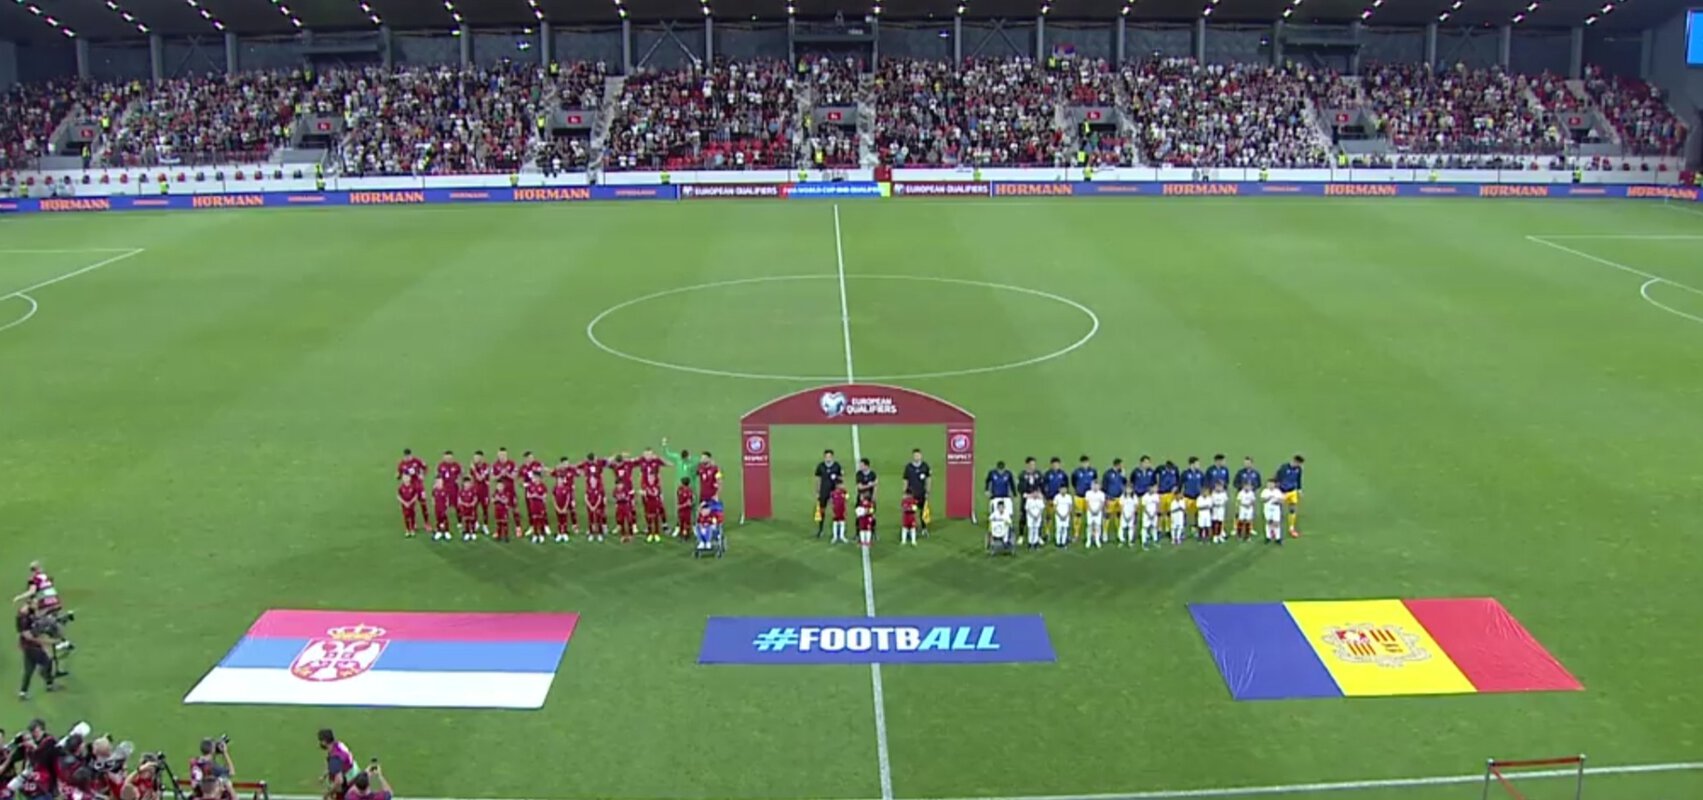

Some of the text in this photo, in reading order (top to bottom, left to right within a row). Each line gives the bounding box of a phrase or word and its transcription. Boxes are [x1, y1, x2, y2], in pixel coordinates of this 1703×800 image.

[695, 186, 778, 195] EUROPEAN QUALIFIERS
[906, 184, 988, 194] EUROPEAN QUALIFIERS
[846, 404, 898, 414] QUALIFIERS
[753, 625, 1001, 652] #FOOTBALL
